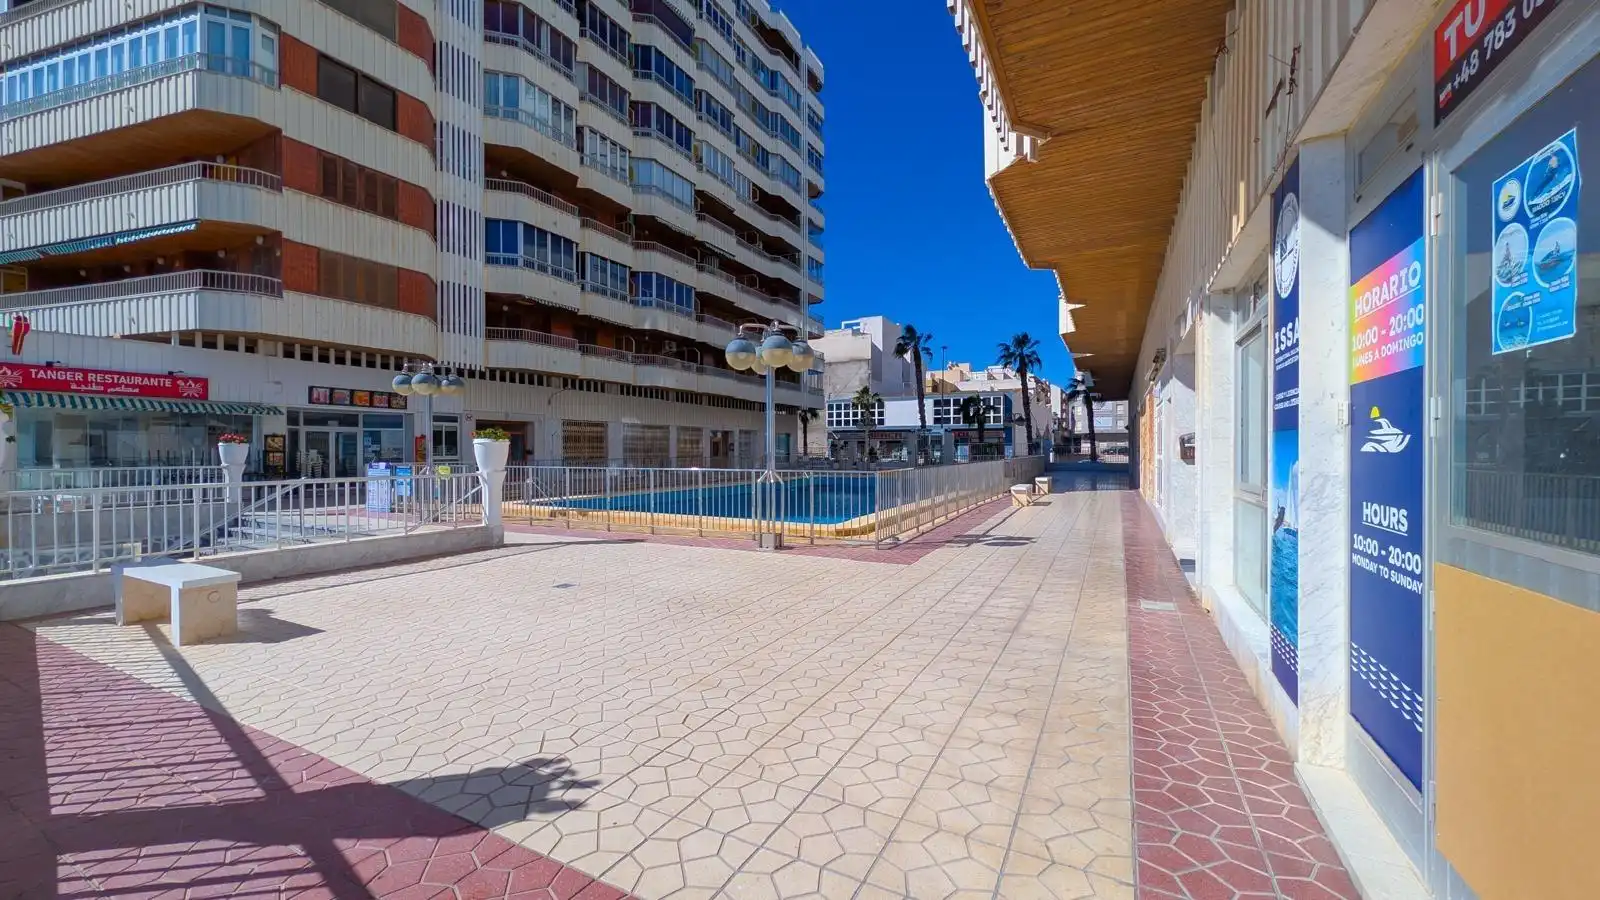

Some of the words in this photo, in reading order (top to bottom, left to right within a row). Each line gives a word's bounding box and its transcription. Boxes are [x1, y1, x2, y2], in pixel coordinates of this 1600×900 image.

[1453, 49, 1479, 89] +48
[1483, 6, 1516, 60] 783
[1354, 261, 1421, 318] HORARIO
[1274, 316, 1299, 354] ISSA
[1352, 326, 1378, 351] 10:00
[1389, 303, 1424, 336] 20:00
[1374, 350, 1380, 360] A
[1381, 332, 1424, 358] DOMINGO
[29, 368, 84, 382] TANGER
[87, 373, 173, 388] RESTAURANTE
[70, 382, 104, 392] طنجة
[107, 384, 140, 393] مطعم
[1362, 501, 1408, 533] HOURS
[1352, 552, 1378, 574] MONDAY
[1379, 564, 1389, 579] TO
[1390, 569, 1423, 595] SUNDAY
[1353, 533, 1379, 557] 10:00
[1388, 545, 1422, 576] 20:00
